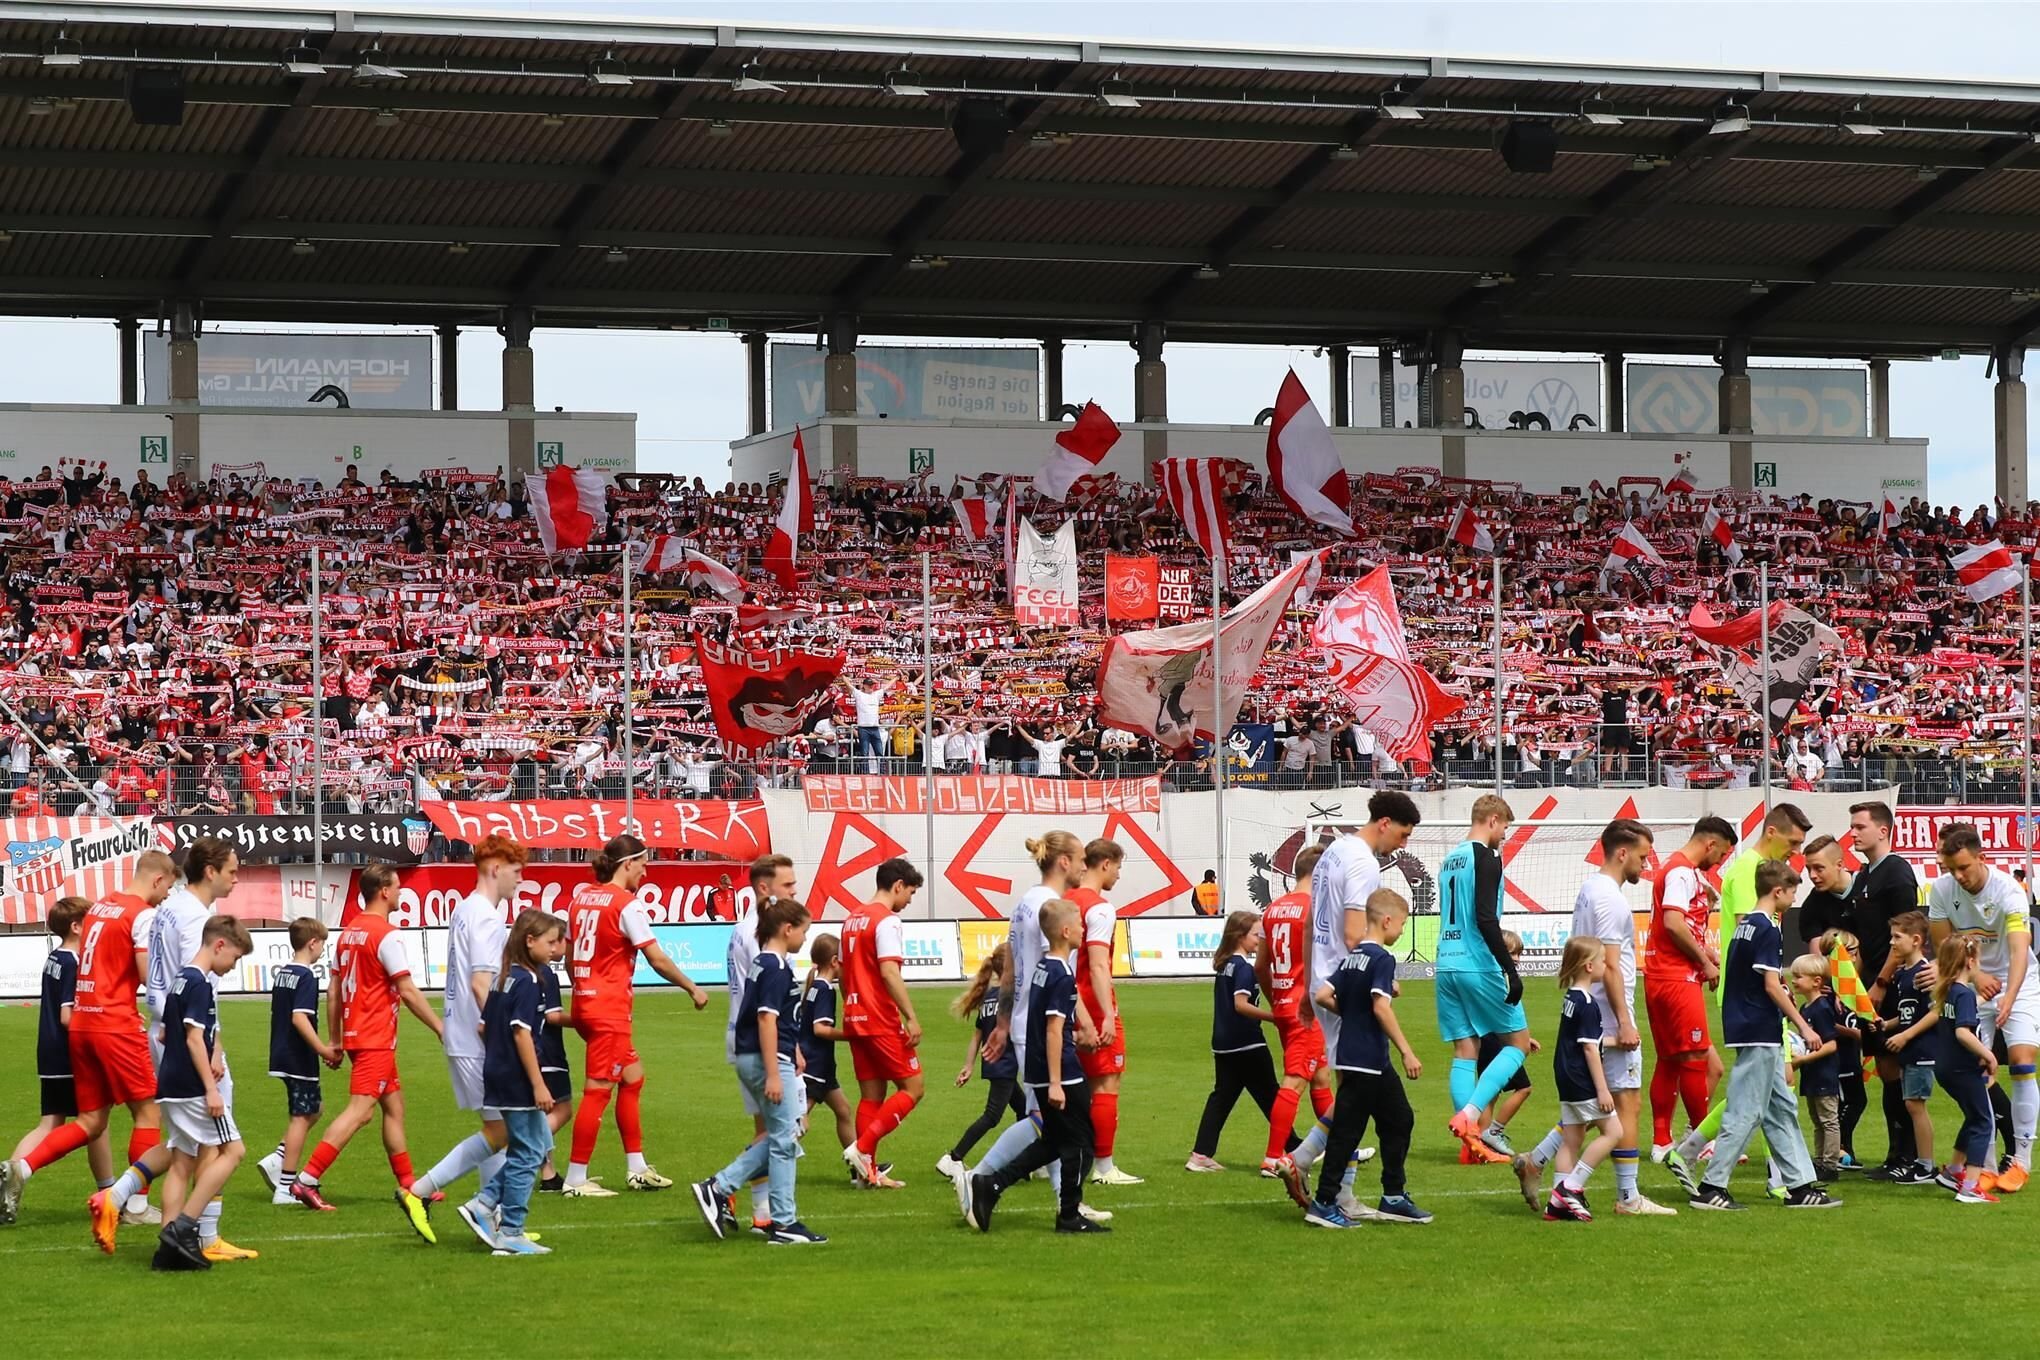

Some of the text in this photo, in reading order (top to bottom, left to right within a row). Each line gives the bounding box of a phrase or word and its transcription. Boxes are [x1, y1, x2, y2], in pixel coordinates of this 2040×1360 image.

[353, 445, 362, 459] B
[582, 458, 621, 467] AUSGANG
[1882, 479, 1916, 488] AUSGANG
[1160, 568, 1190, 584] NUR
[1014, 585, 1074, 607] FEEL
[1160, 585, 1190, 601] DER
[1159, 604, 1190, 619] FSV
[518, 640, 559, 648] SACHSENRING
[804, 776, 906, 813] GEGEN
[1894, 815, 2011, 849] HAEN
[69, 821, 150, 870] Fraureuth
[1271, 922, 1292, 974] 13
